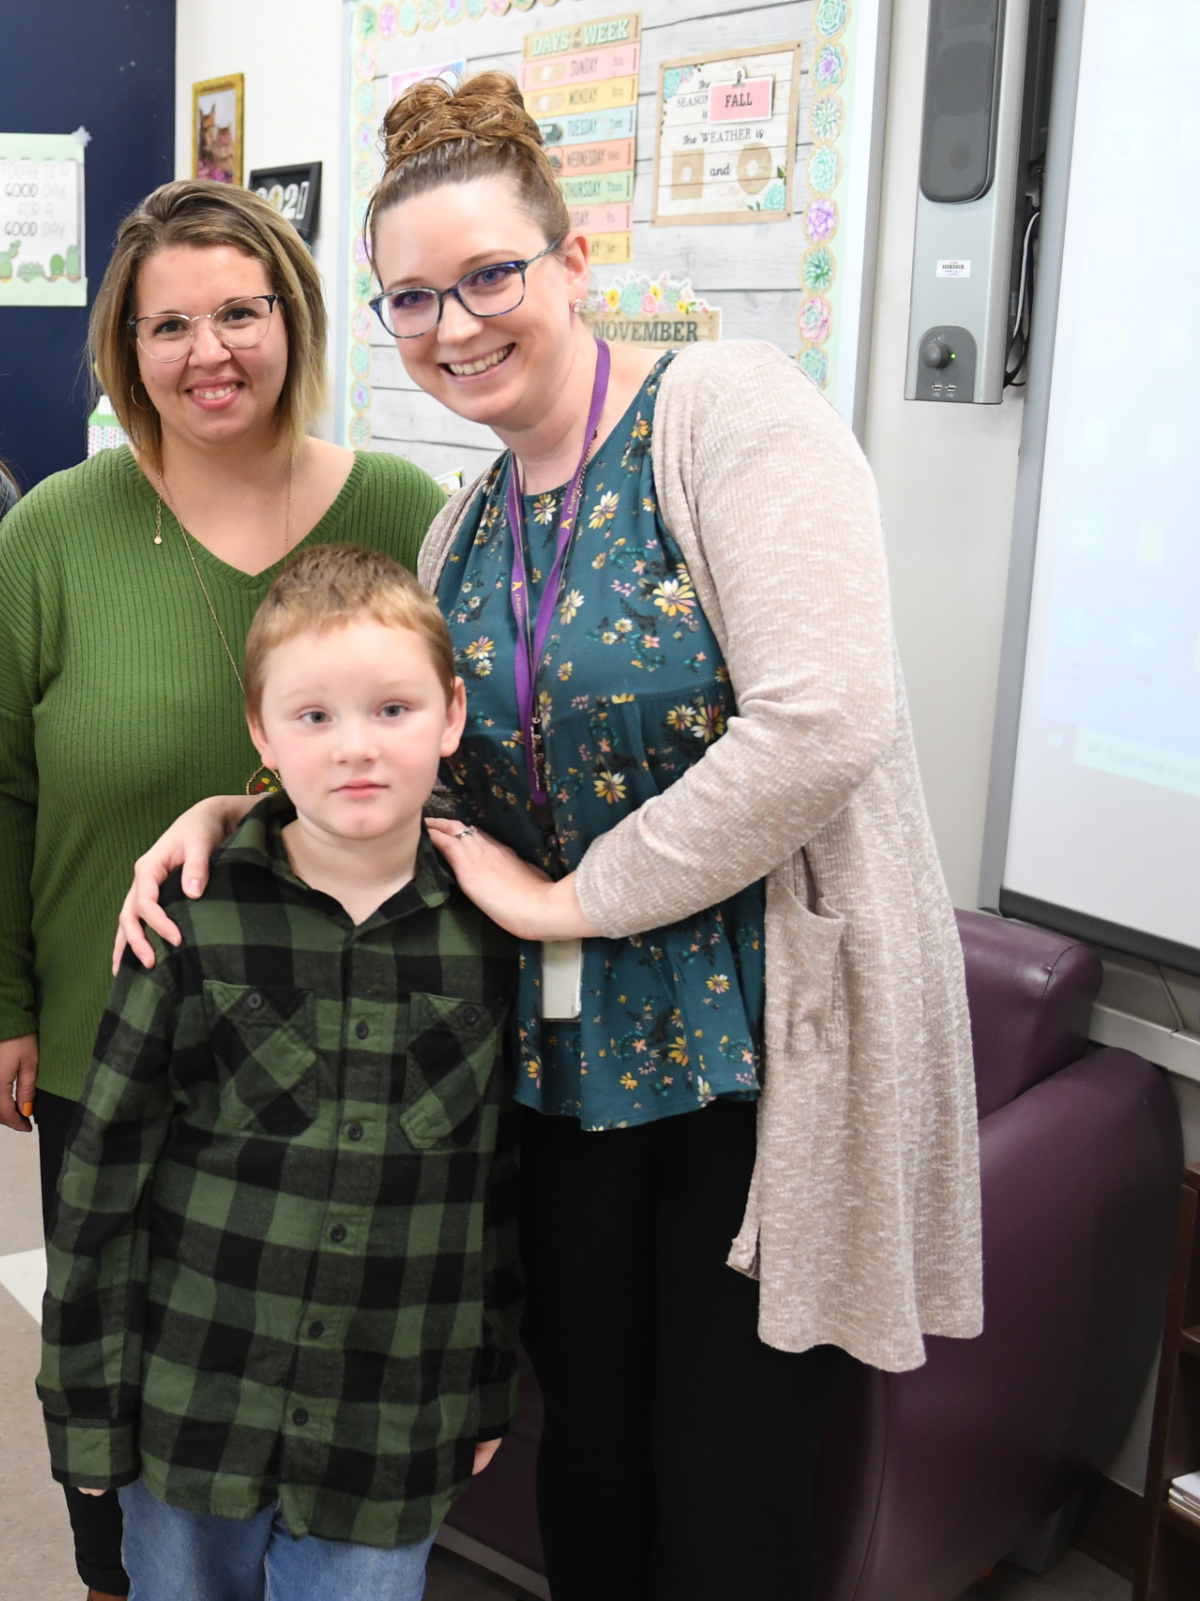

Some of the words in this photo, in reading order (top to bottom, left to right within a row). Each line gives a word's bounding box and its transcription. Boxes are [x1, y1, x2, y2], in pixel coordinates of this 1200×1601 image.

[533, 31, 570, 56] DAYS
[584, 19, 630, 46] WEEK
[570, 57, 599, 77] SUNDAY
[569, 86, 598, 106] MONDAY
[724, 92, 753, 109] FALL
[567, 118, 598, 137] TUESDAY
[700, 128, 752, 144] WEATHER
[566, 148, 606, 169] WEDNESDAY
[709, 162, 731, 177] and
[5, 183, 38, 198] GOOD
[565, 179, 601, 198] THURSDAY
[4, 221, 38, 236] GOOD
[593, 320, 699, 343] NOVEMBER
